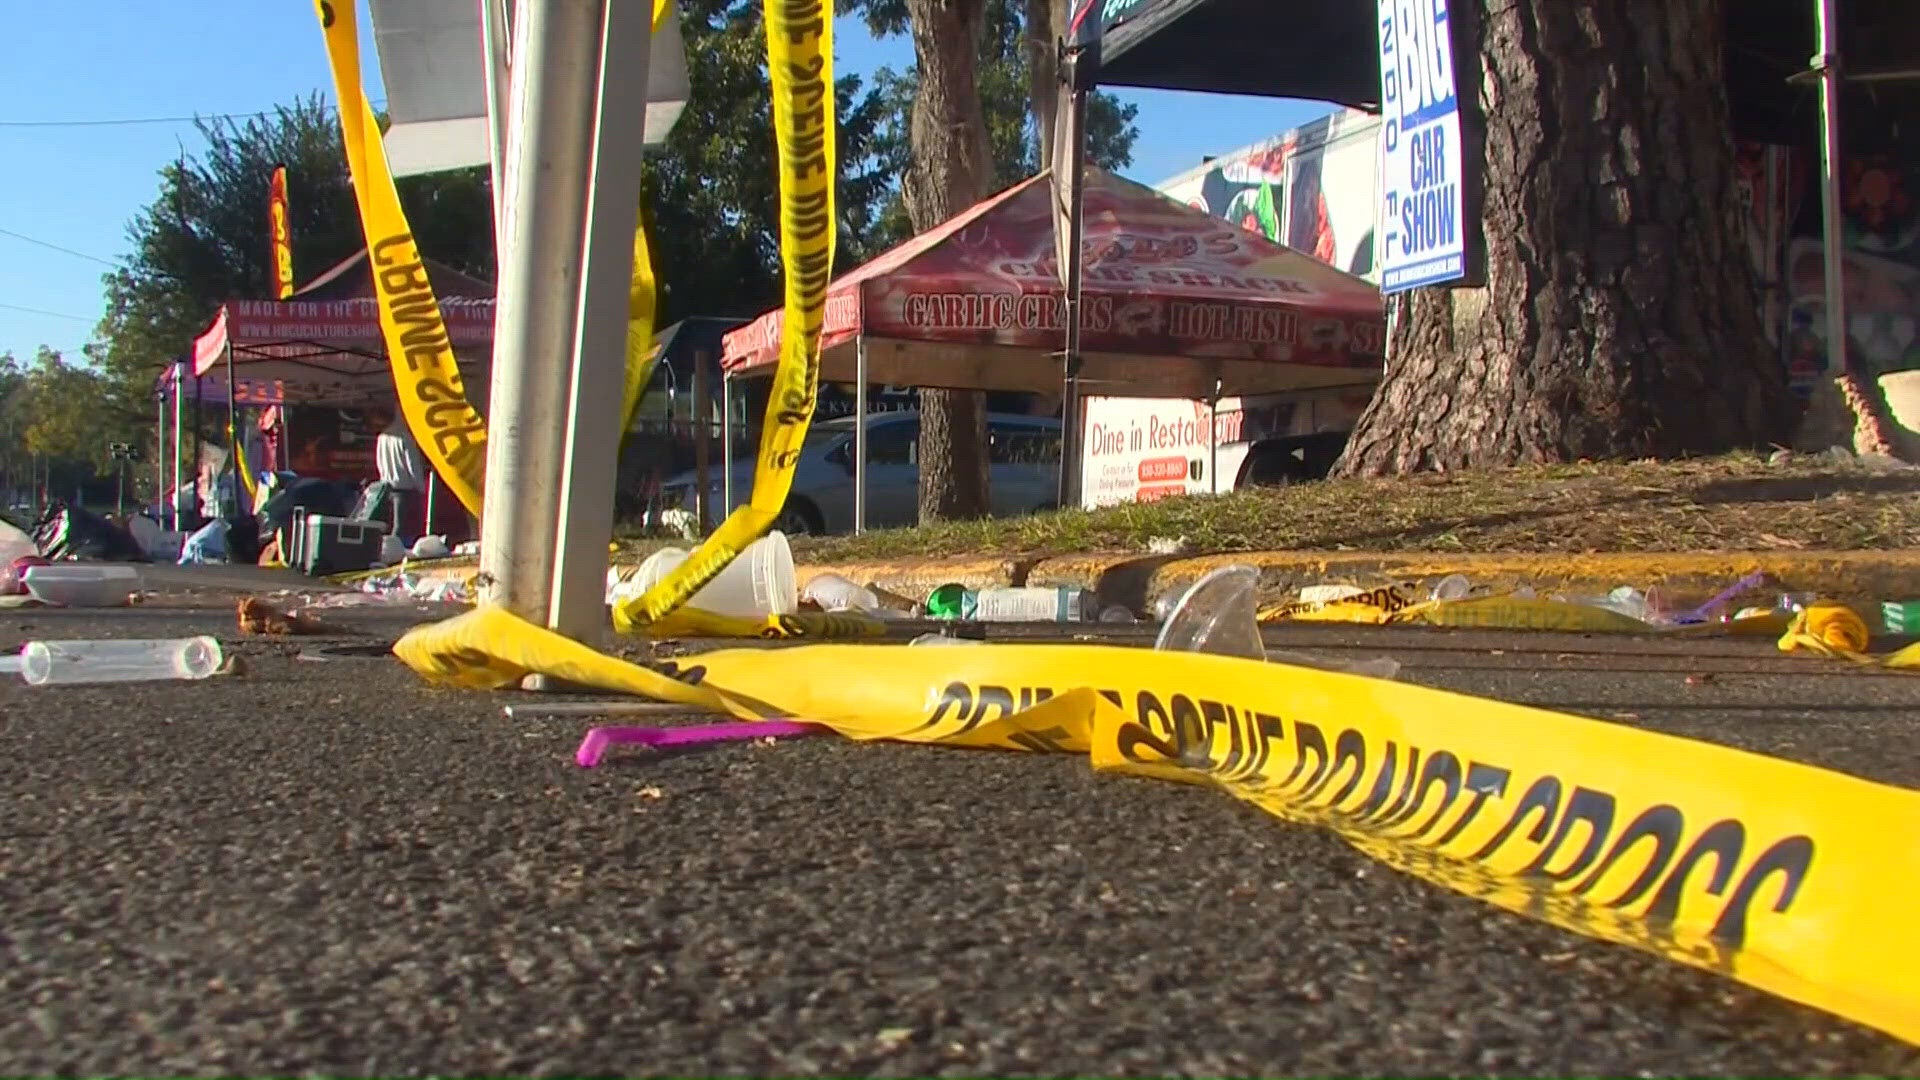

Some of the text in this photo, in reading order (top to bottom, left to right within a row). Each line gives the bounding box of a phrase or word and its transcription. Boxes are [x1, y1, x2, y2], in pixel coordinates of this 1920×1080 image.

[1395, 0, 1455, 117] BIG
[1411, 125, 1445, 192] CAR
[1402, 183, 1454, 256] SHOW
[239, 301, 282, 318] MADE
[289, 302, 317, 318] FOR
[326, 303, 353, 318] THE
[904, 293, 1012, 330] GARLIC
[1169, 302, 1301, 345] HOT FISH
[1092, 422, 1125, 456] Dine
[1131, 420, 1143, 452] in
[1354, 741, 1512, 848] NOT
